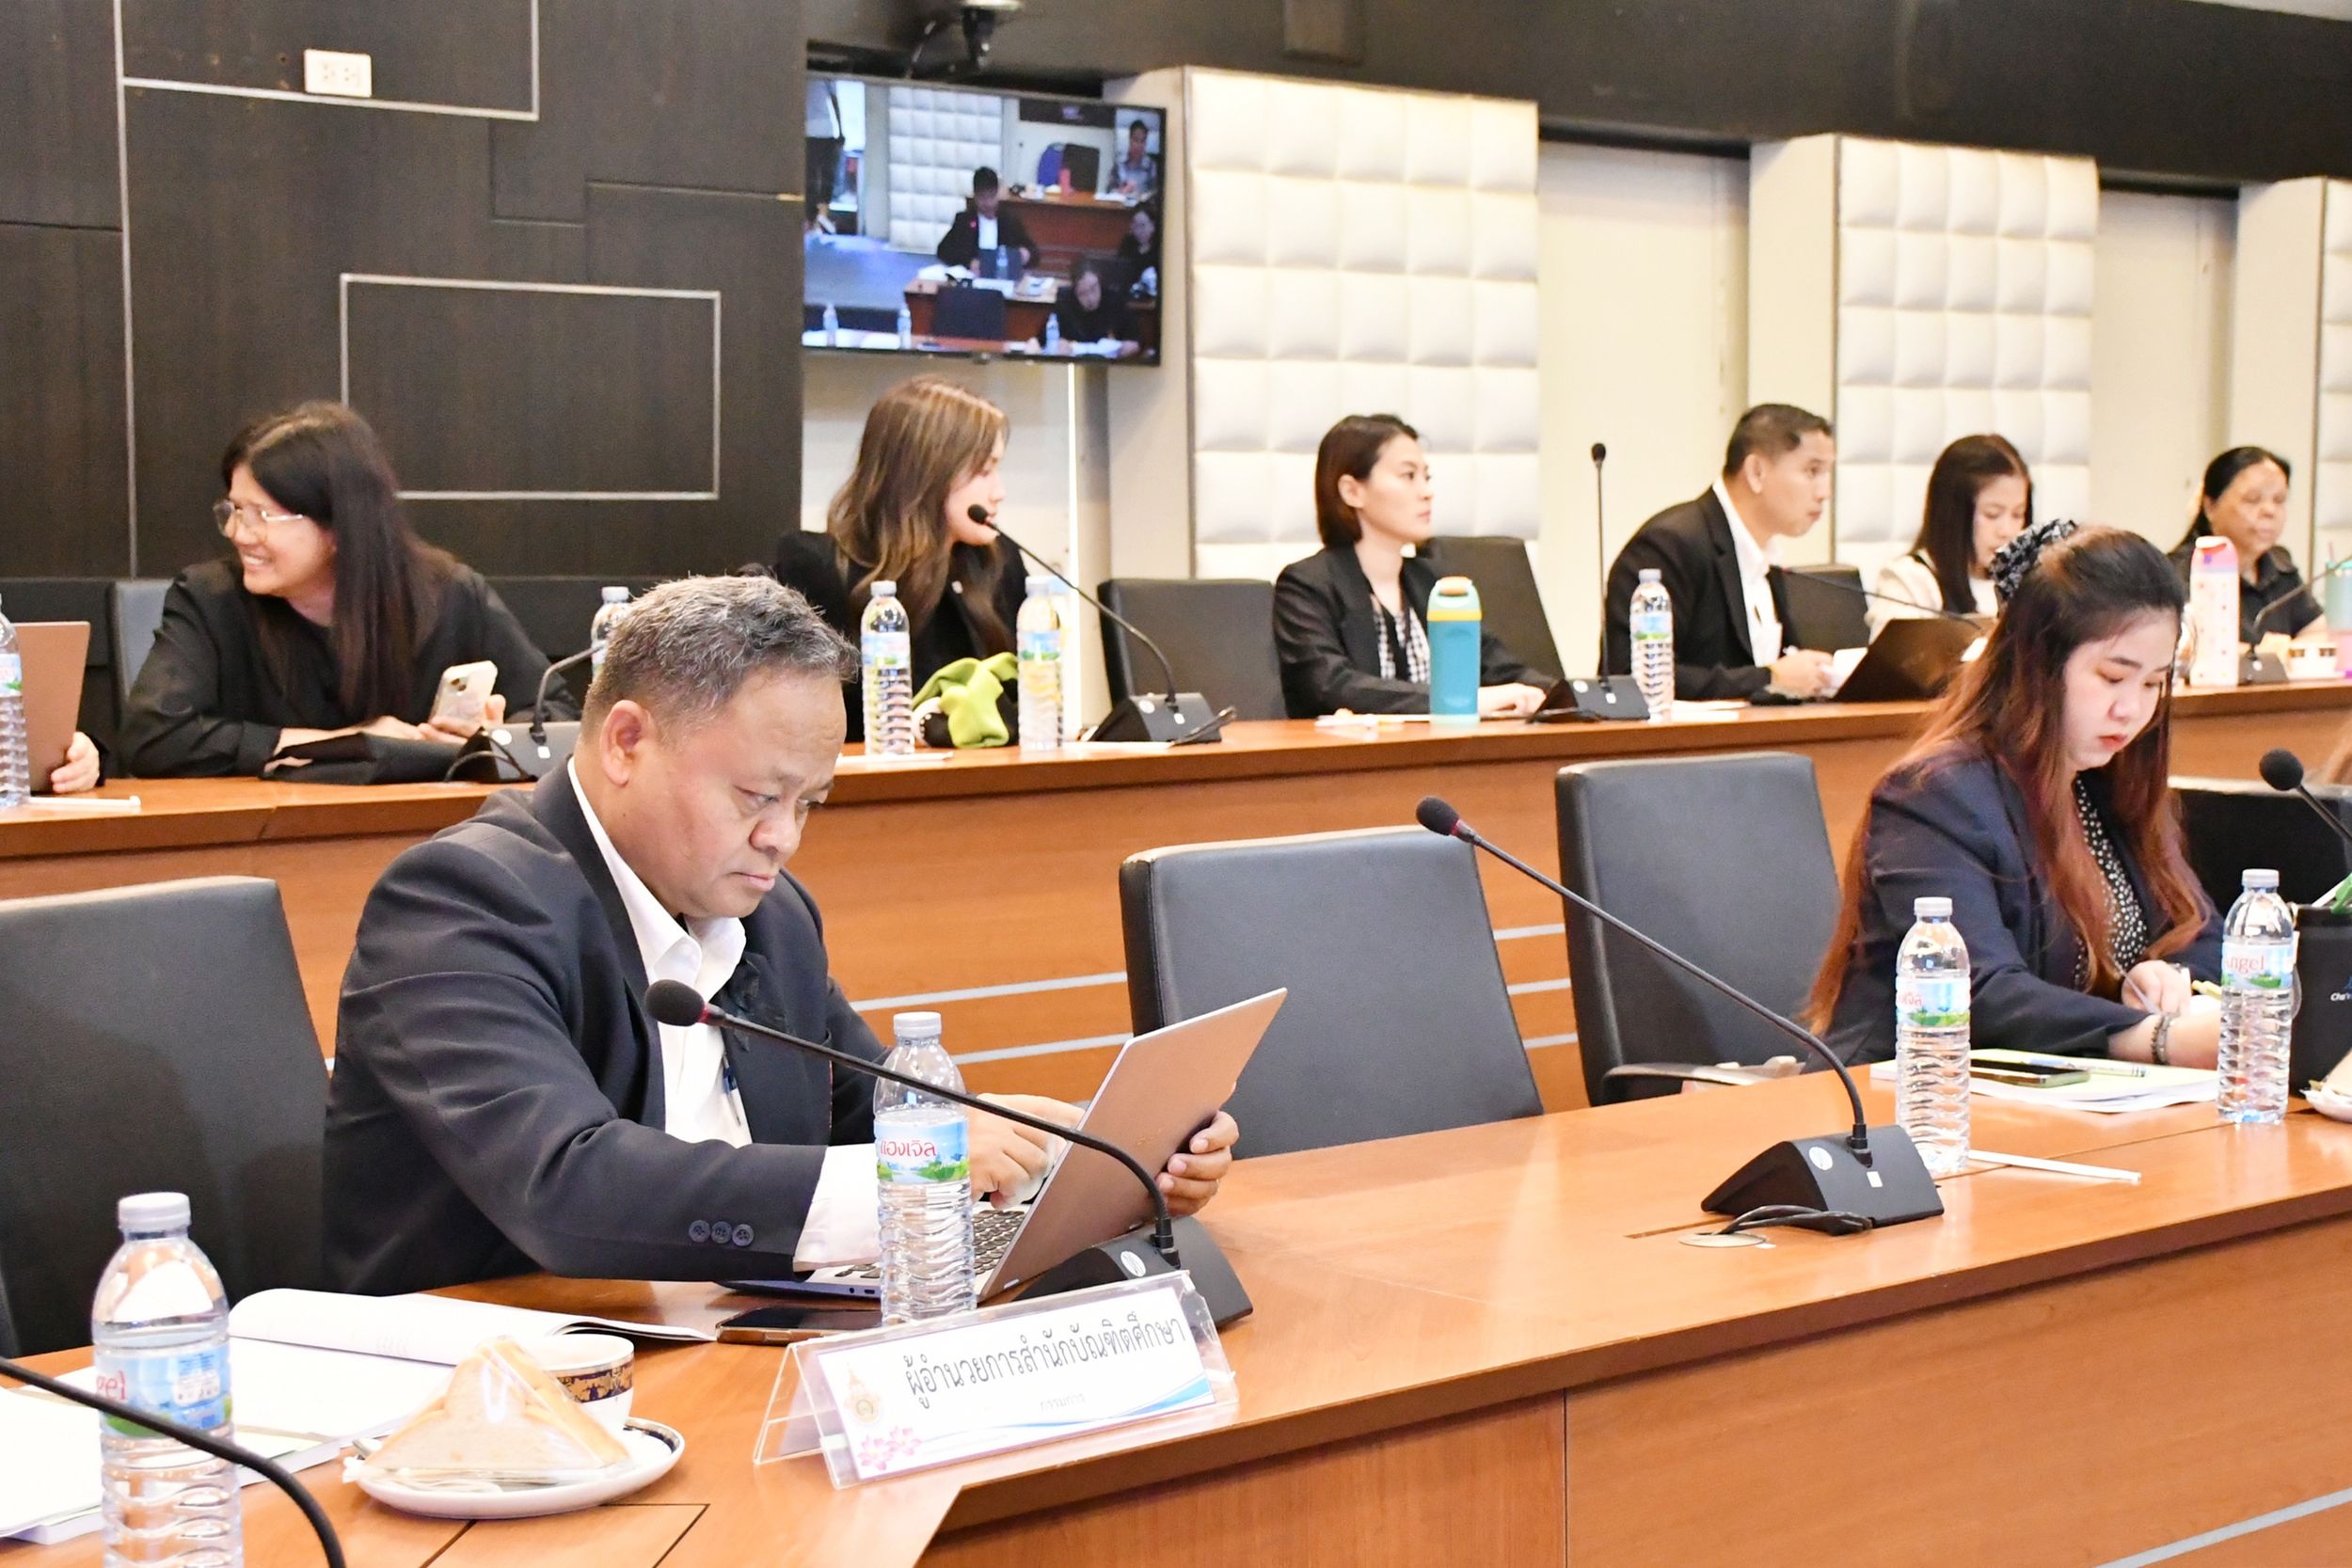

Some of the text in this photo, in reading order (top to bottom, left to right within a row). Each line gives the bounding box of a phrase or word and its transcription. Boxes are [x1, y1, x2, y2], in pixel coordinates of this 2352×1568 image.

[2226, 955, 2265, 974] ngel
[880, 1139, 937, 1157] แองเจิล
[903, 1311, 1187, 1409] ผู้อำนวยการสำนักบัณฑิตศึกษา
